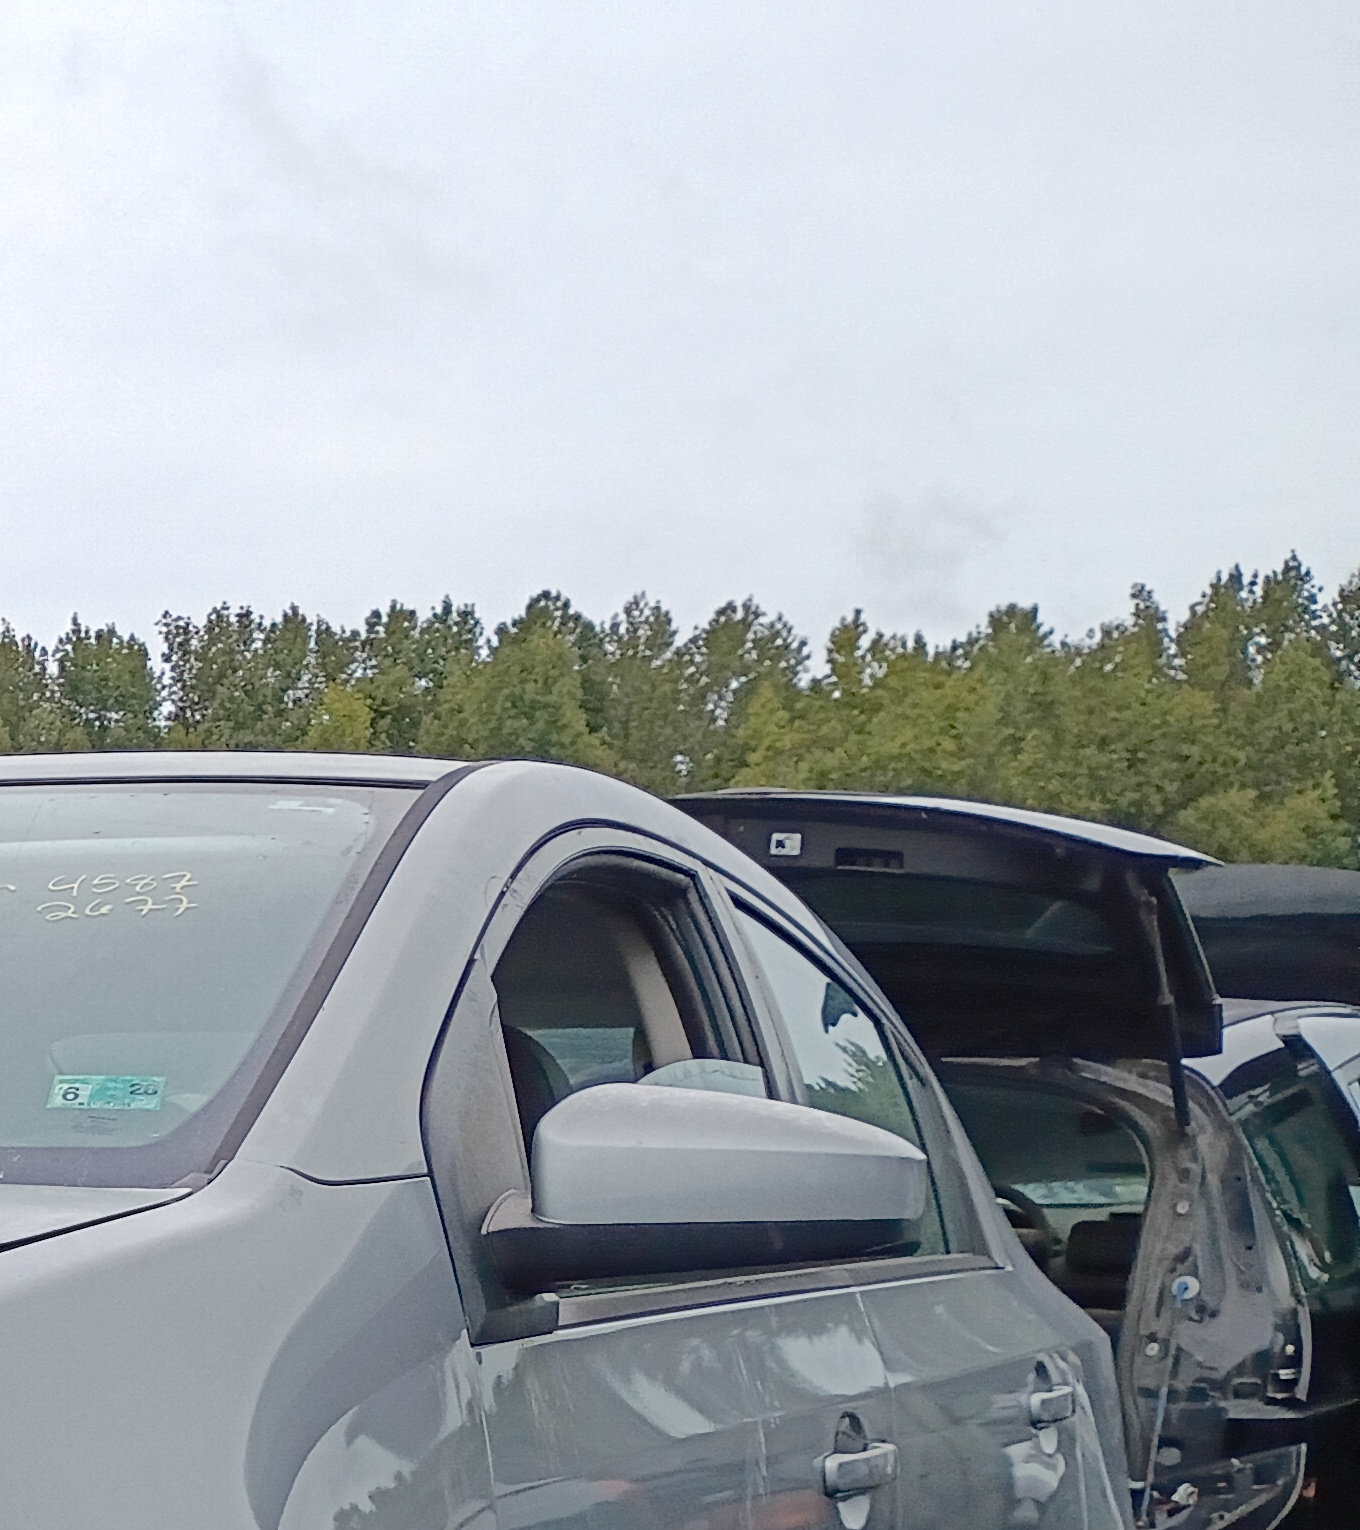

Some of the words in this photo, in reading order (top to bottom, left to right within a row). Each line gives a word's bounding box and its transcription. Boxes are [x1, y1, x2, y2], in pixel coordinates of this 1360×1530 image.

[48, 871, 198, 896] 4587
[37, 895, 198, 921] 2677
[61, 1086, 80, 1102] 6
